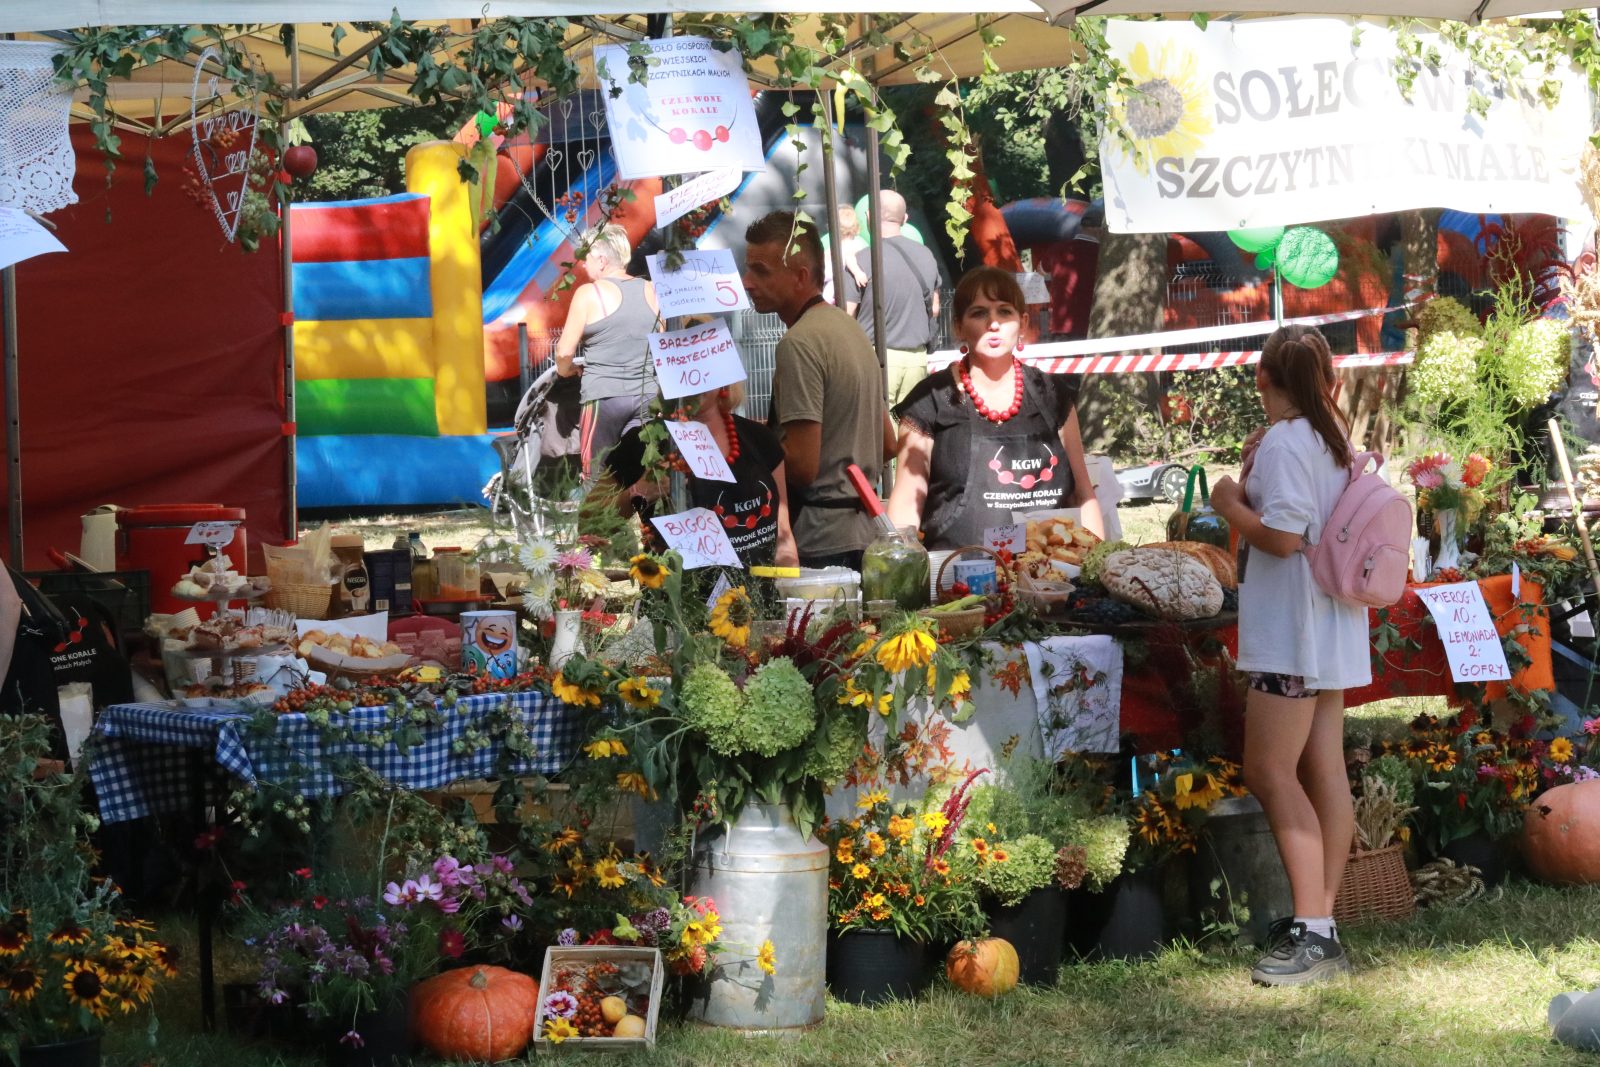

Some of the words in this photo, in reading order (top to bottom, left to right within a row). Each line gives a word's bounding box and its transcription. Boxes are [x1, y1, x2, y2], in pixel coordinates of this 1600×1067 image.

[652, 44, 673, 53] OŁO
[648, 69, 706, 81] ZCZYTNIKACH
[661, 95, 722, 105] CZERWONE
[672, 106, 719, 116] KORALE
[1439, 142, 1551, 185] MAŁE
[715, 280, 739, 307] 5
[659, 327, 719, 351] BARSZCZ
[666, 339, 733, 367] PASZTECIKIEM
[1011, 458, 1042, 470] KGW
[983, 492, 1032, 501] CZERWONE
[1033, 488, 1063, 499] KORALE
[734, 496, 761, 513] KGW
[664, 515, 720, 536] BIGOS
[1429, 590, 1477, 604] PIEROGI
[1449, 629, 1496, 643] LEMONIADA
[67, 648, 97, 660] KORALE
[1459, 663, 1504, 677] GOFRY
